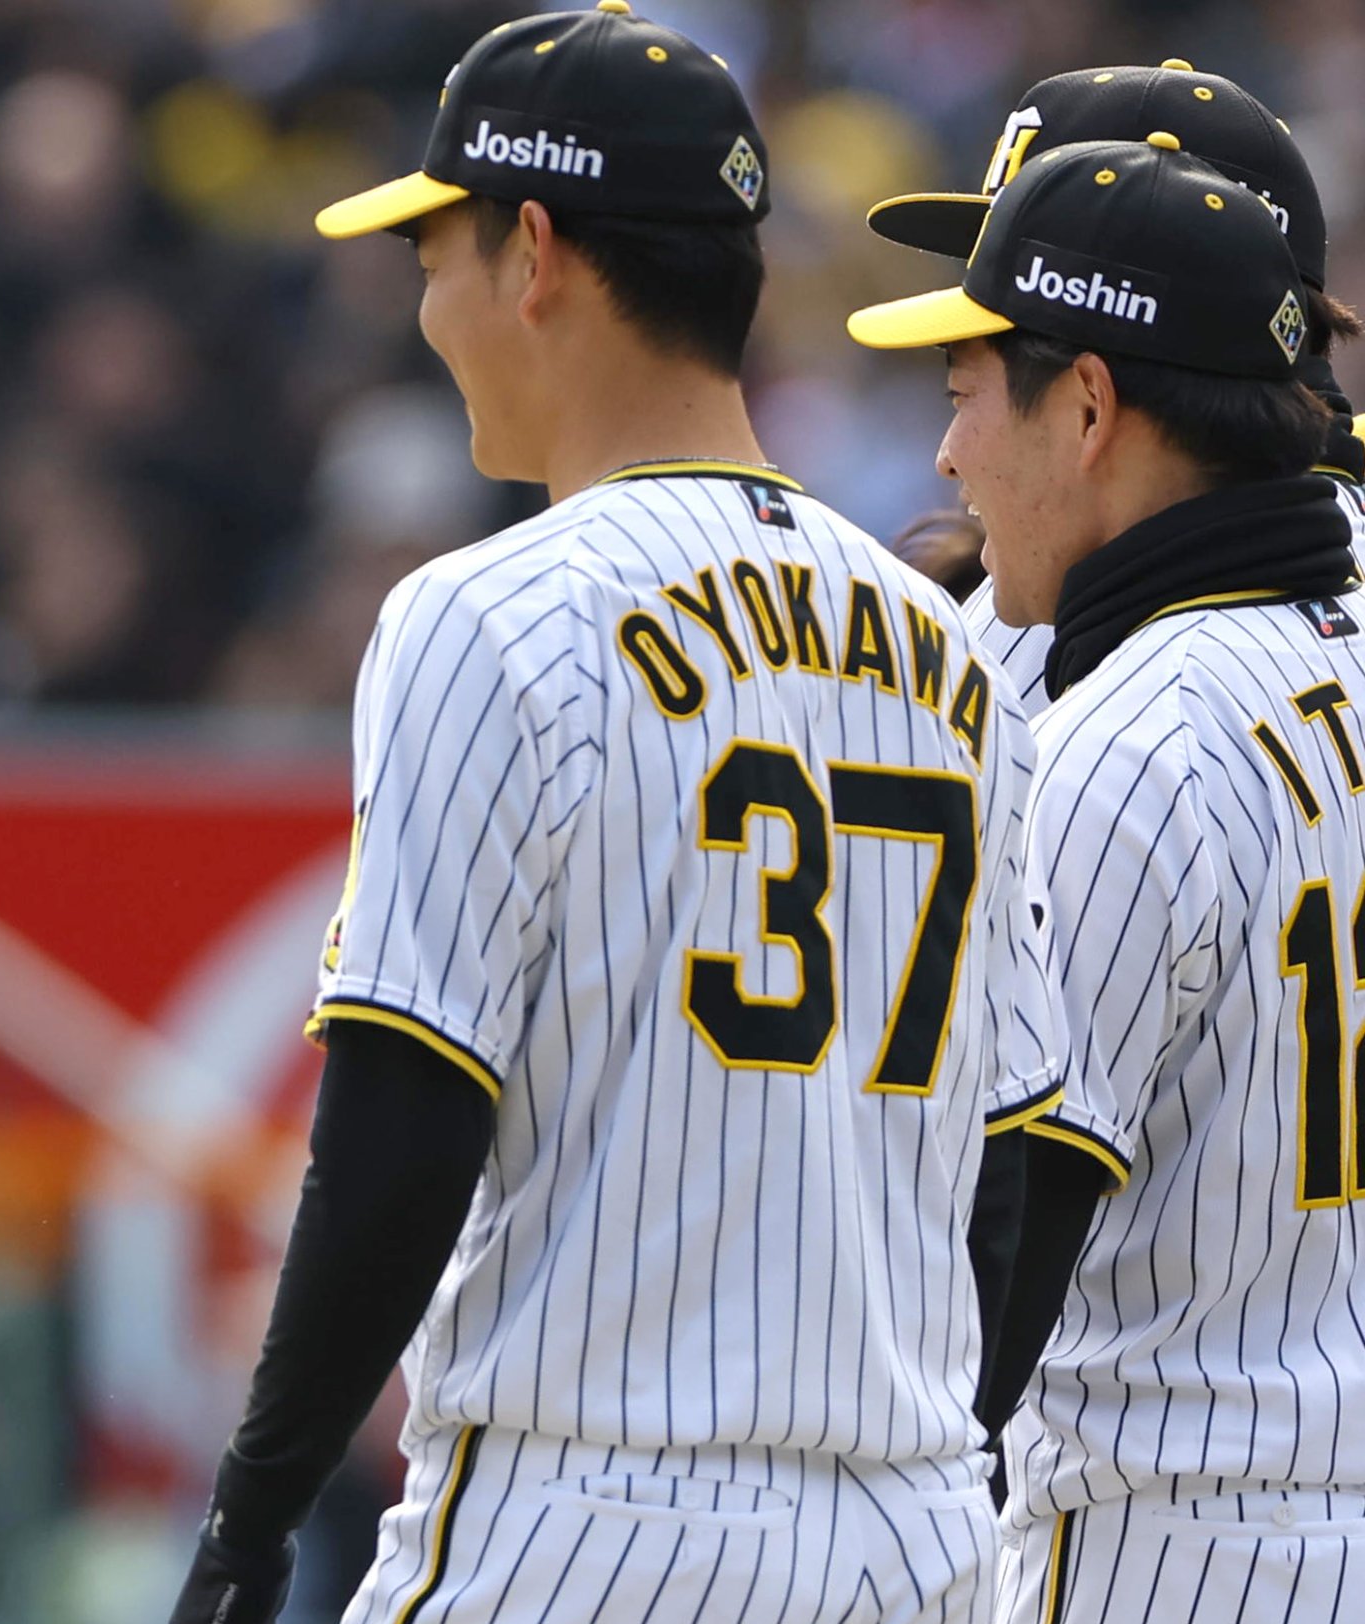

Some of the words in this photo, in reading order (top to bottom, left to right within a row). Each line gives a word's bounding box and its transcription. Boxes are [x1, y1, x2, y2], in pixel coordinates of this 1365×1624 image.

[463, 120, 604, 178] Joshin
[1015, 256, 1158, 325] Joshin
[615, 556, 992, 775] OYOKAWA
[680, 736, 981, 1096] 37
[1277, 877, 1365, 1211] 1
